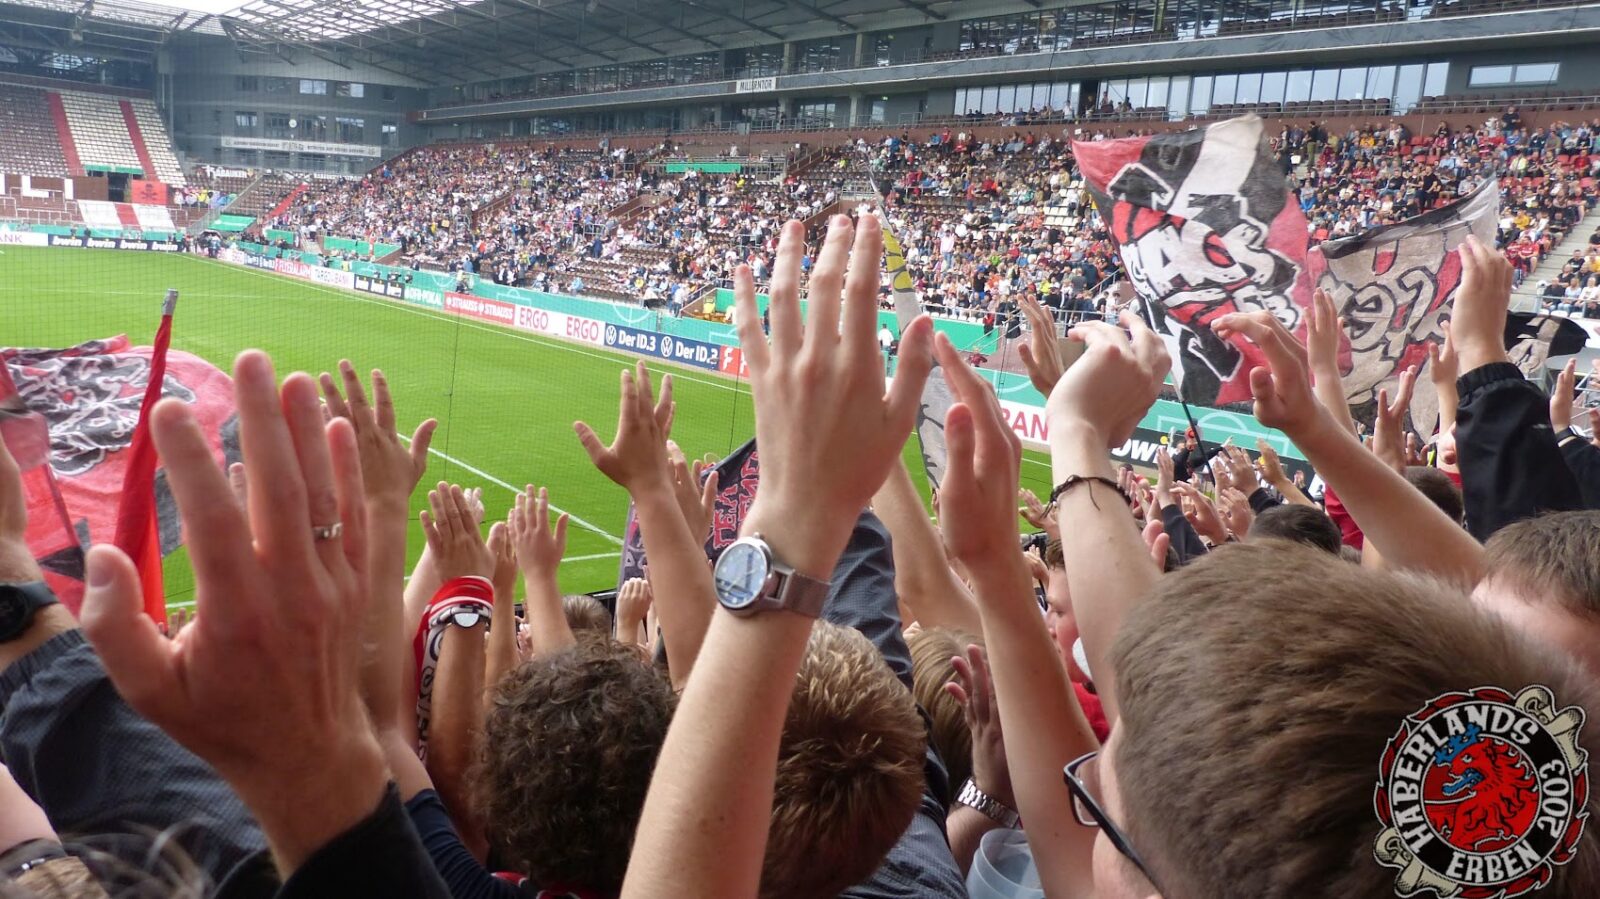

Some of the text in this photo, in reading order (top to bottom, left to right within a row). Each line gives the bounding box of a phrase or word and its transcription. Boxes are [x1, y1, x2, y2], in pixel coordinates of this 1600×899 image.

[52, 236, 83, 247] bwin
[86, 237, 117, 249] bwin
[119, 239, 148, 250] bwin
[151, 241, 179, 251] bwin
[452, 297, 514, 320] STRAUSS STRAUSS
[520, 307, 549, 330] ERGO
[566, 316, 599, 341] ERGO
[618, 330, 636, 348] Der
[637, 334, 657, 352] ID.3
[675, 341, 695, 359] Der
